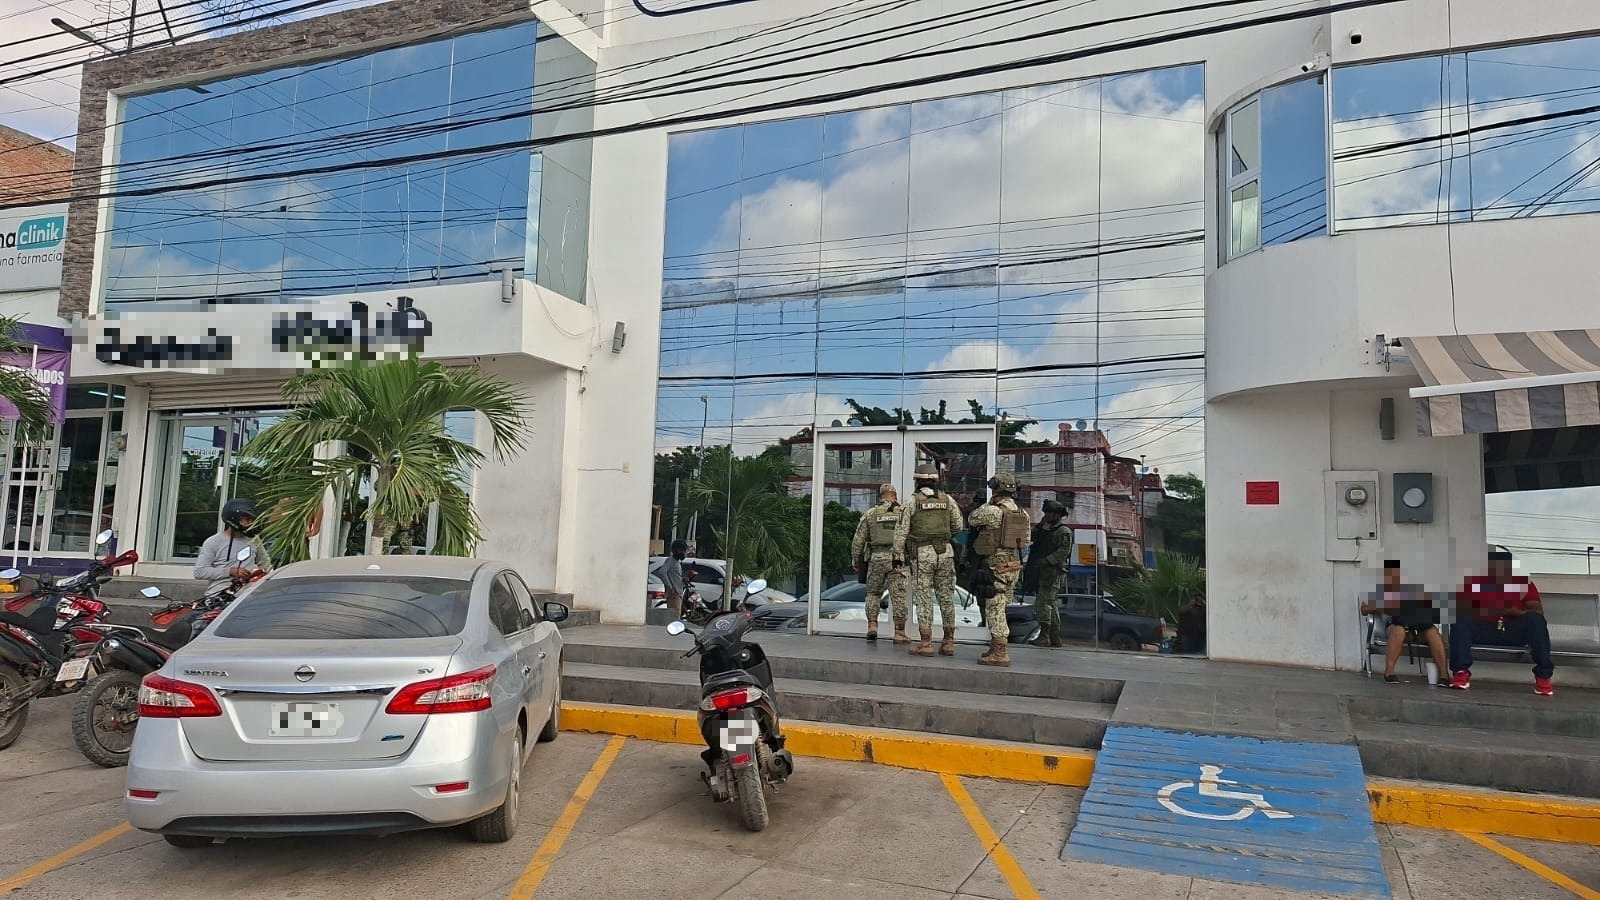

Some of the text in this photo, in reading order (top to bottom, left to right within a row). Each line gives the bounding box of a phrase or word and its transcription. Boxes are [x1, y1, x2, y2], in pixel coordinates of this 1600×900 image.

[18, 250, 63, 265] farmacia
[921, 502, 947, 510] EJERCITO
[183, 668, 230, 678] SENTRA
